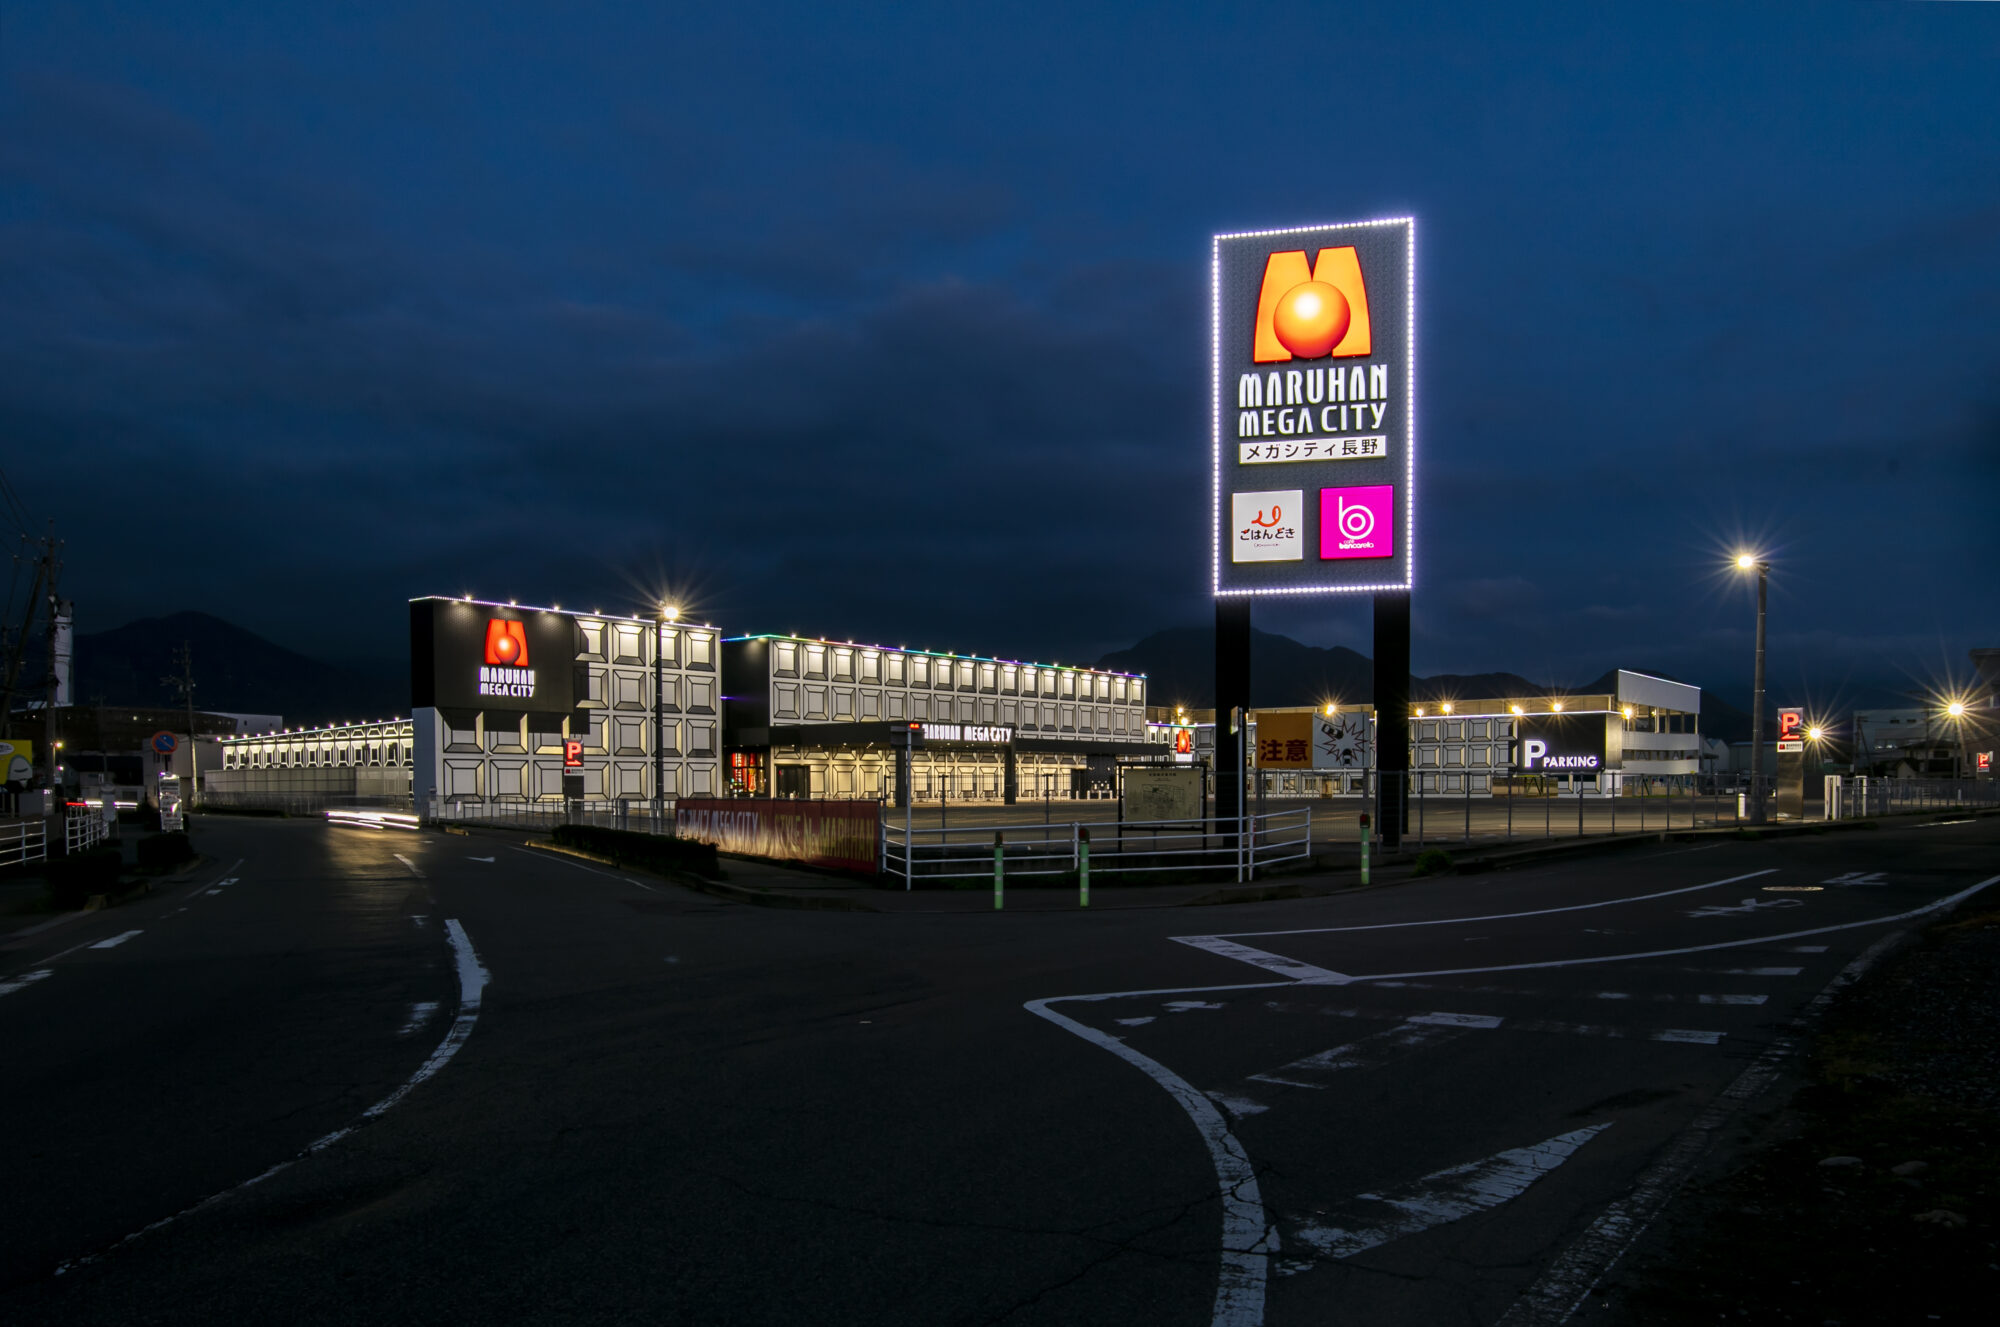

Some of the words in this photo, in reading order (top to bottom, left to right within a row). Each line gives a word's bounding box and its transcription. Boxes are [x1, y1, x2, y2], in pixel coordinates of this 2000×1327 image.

[1239, 364, 1388, 408] MARUHAN
[1239, 407, 1314, 437] MEGA
[1321, 402, 1387, 432] CITY
[1246, 438, 1378, 460] メガシティ長野
[1240, 528, 1296, 541] ごはんどき
[480, 666, 535, 685] MARUHAN
[480, 682, 509, 696] MEGA
[510, 684, 535, 698] CITY
[964, 725, 989, 741] MEGA
[1781, 712, 1800, 734] P
[566, 741, 582, 760] P
[1260, 739, 1308, 761] 注意
[1524, 740, 1547, 768] P
[1543, 756, 1598, 768] PARKING
